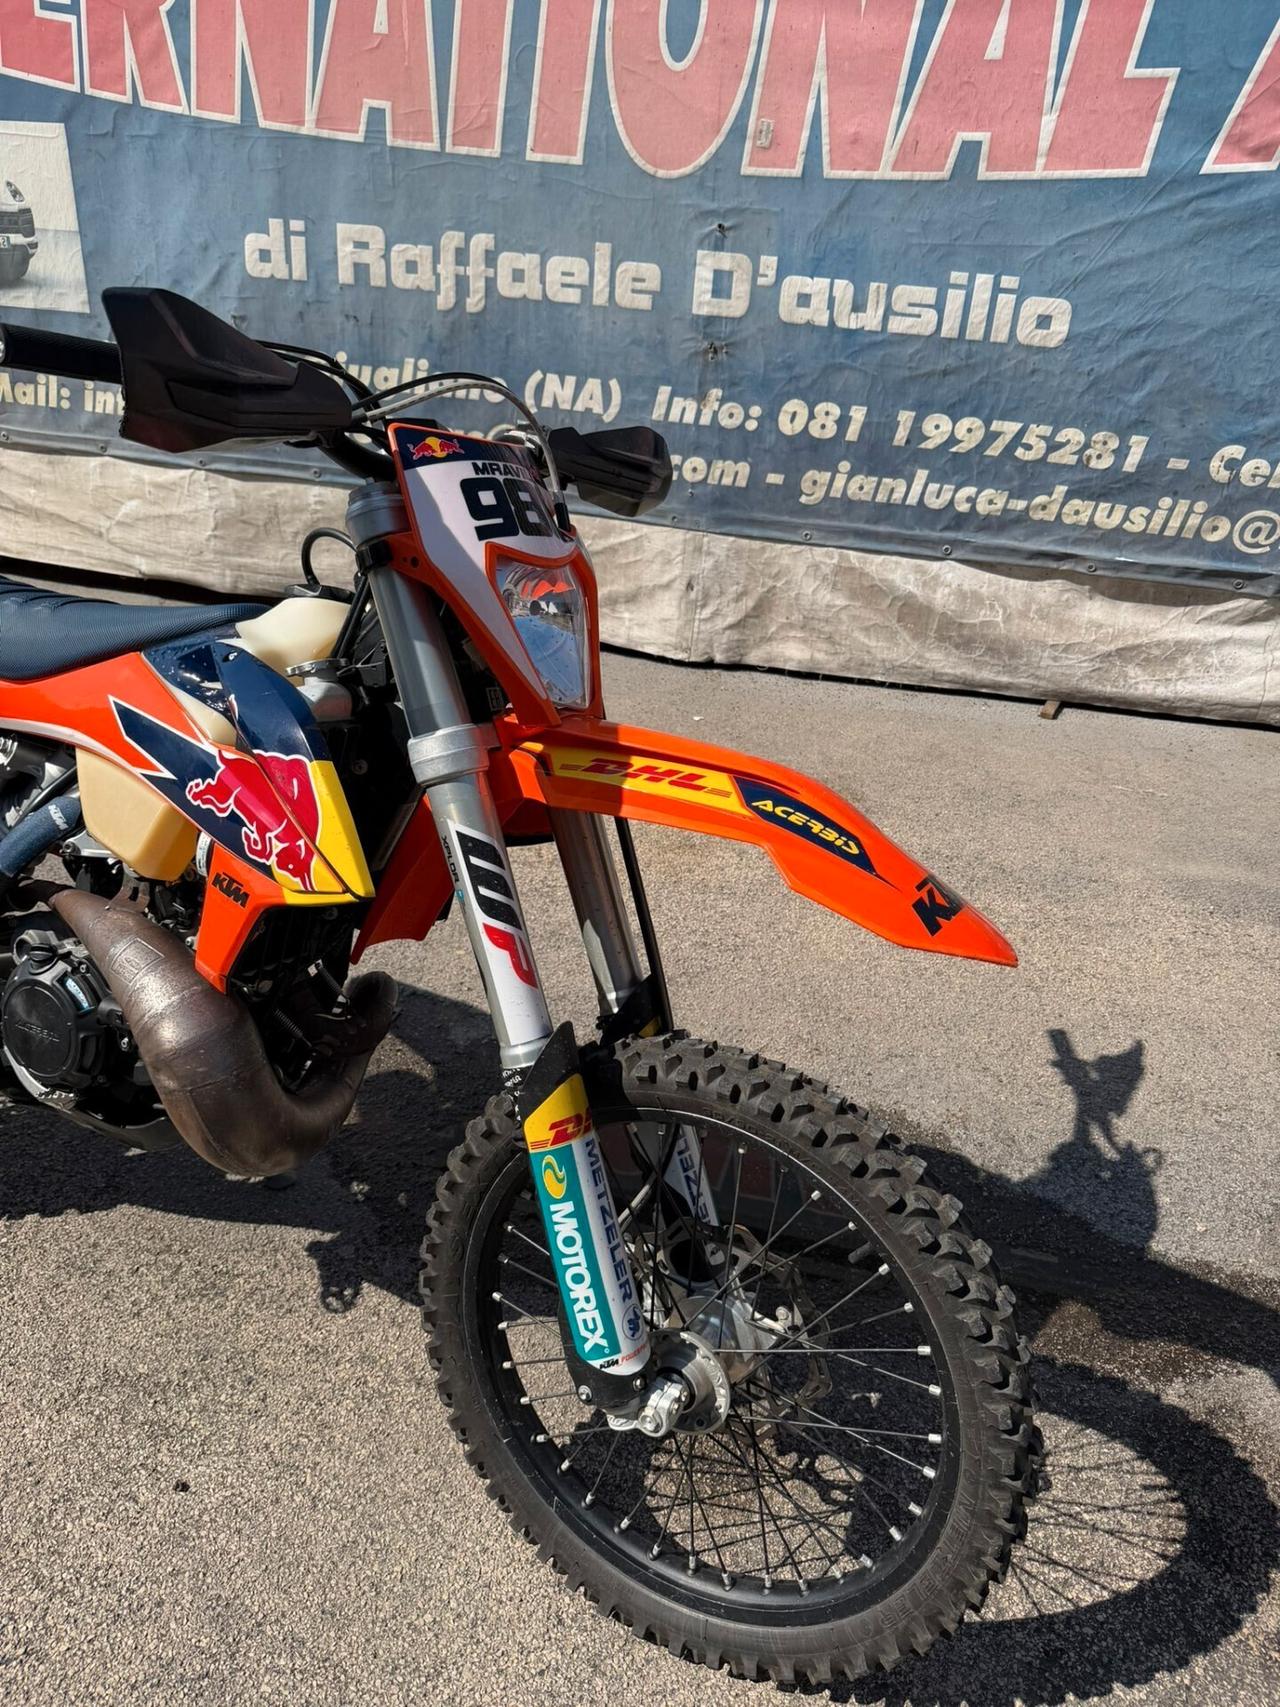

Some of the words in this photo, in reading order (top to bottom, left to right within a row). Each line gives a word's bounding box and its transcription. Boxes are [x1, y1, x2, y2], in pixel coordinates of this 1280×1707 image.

[244, 217, 308, 281] di
[336, 222, 662, 313] Raffaele
[692, 249, 1073, 349] D'ausilio
[525, 369, 622, 424] (NA)
[652, 385, 763, 432] Info:
[777, 398, 868, 439] 081
[891, 410, 1150, 473] 19975281
[580, 757, 709, 793] DHL
[751, 799, 860, 855] ACERBIS
[211, 872, 251, 909] KTM
[585, 1137, 634, 1303] METZELER
[549, 1200, 609, 1353] MOTOREX
[600, 1358, 619, 1370] KTM
